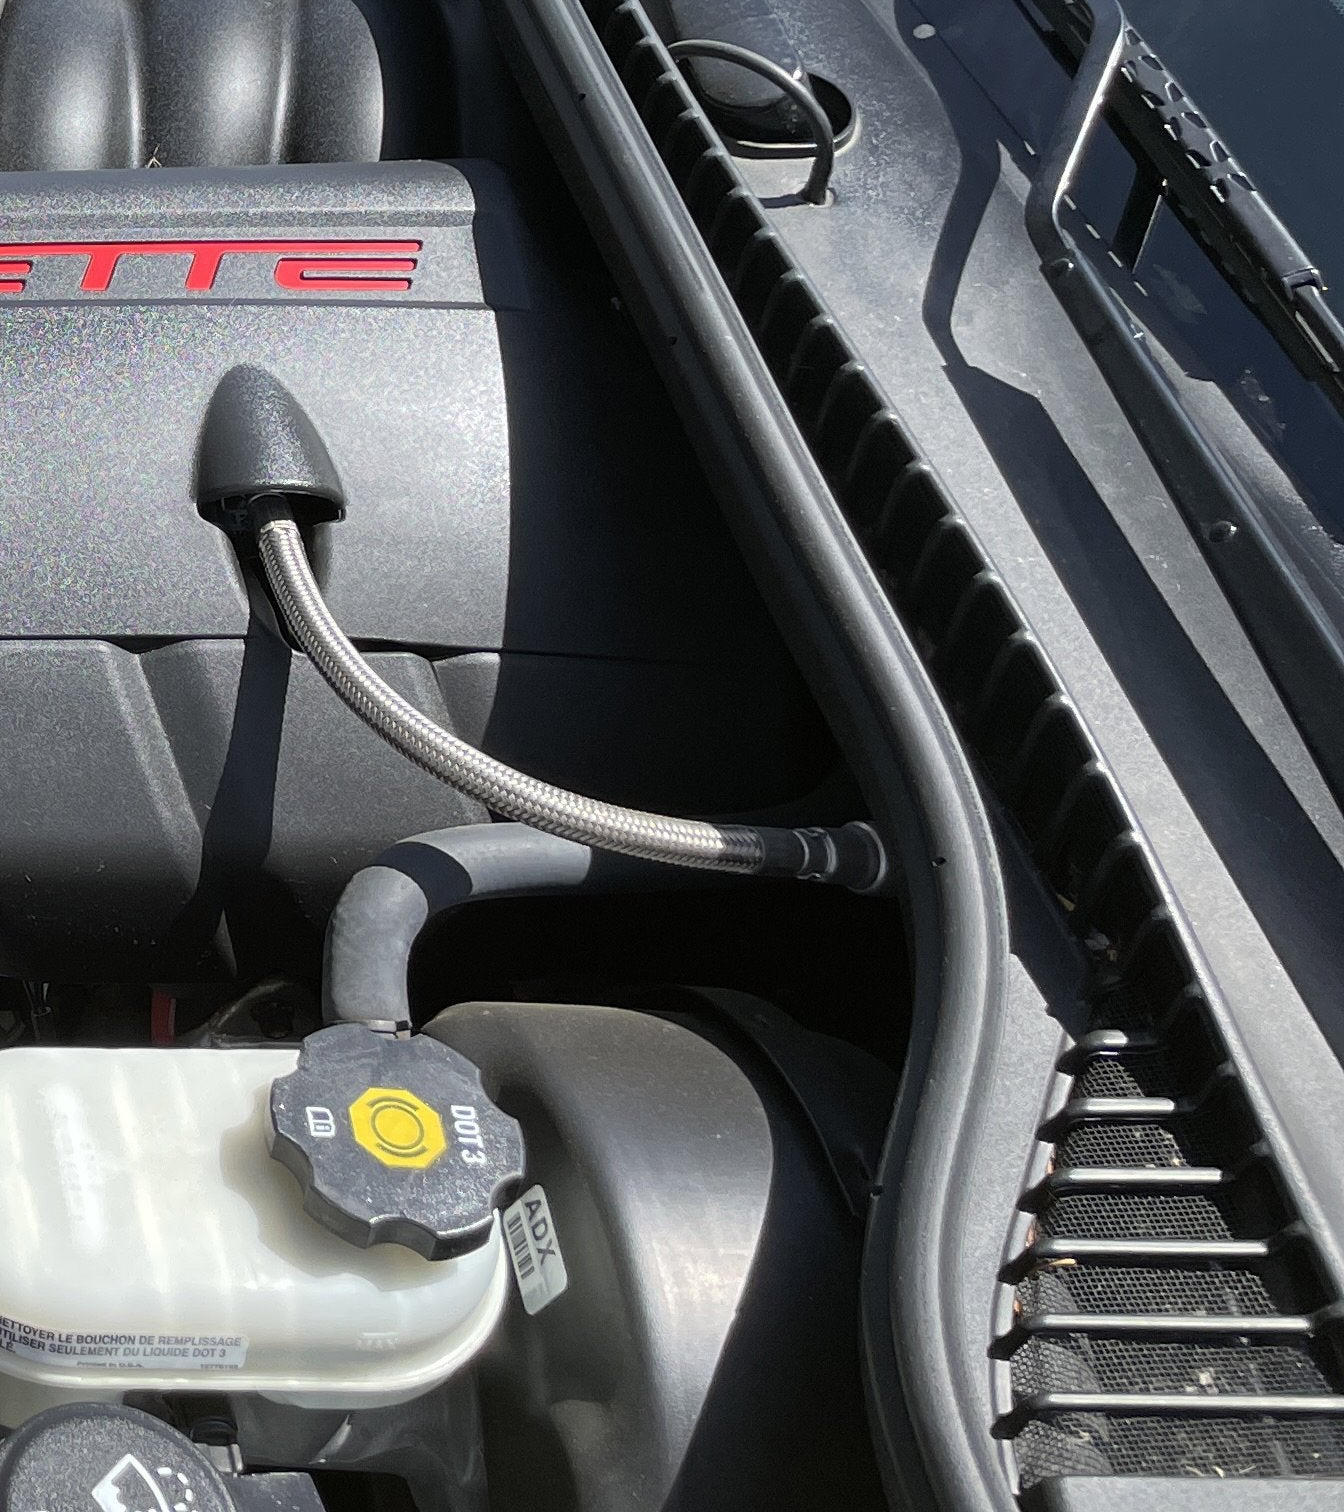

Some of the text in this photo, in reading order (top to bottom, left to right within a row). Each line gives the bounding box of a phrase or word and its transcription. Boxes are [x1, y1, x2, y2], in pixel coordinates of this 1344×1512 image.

[450, 1104, 487, 1166] DOT 3
[524, 1199, 557, 1266] ADX
[48, 1343, 120, 1357] SEULEMENT
[123, 1346, 140, 1357] DU
[143, 1346, 189, 1358] LIQUIDE
[192, 1347, 216, 1358] DOT
[218, 1348, 227, 1358] 3
[58, 1333, 73, 1344] LE
[77, 1334, 136, 1346] BOUCHON
[139, 1335, 155, 1346] DE
[157, 1335, 242, 1347] REMPLISSAGE
